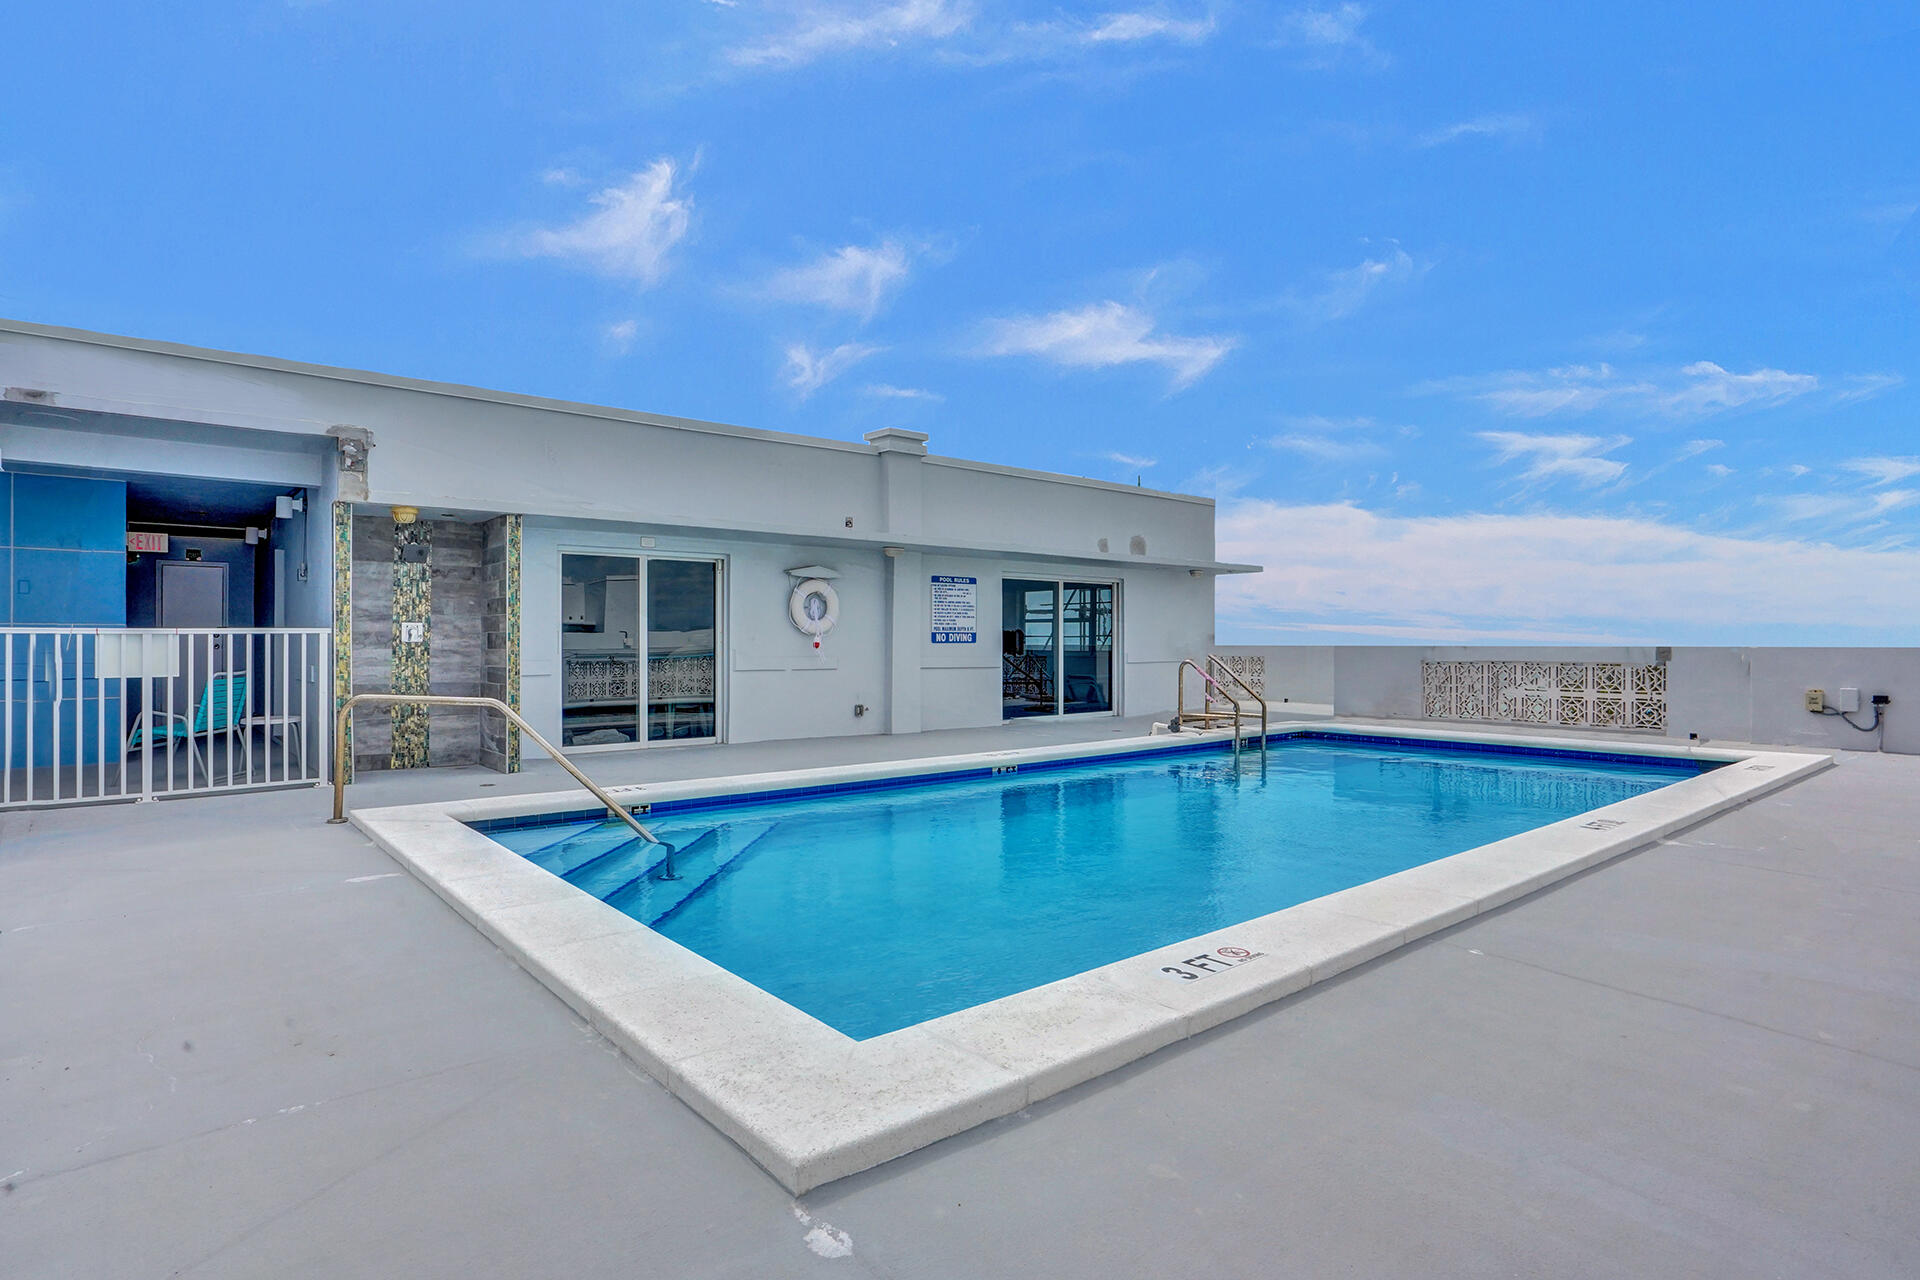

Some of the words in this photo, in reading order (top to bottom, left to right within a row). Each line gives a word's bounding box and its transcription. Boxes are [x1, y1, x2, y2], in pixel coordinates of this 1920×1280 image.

[136, 534, 163, 550] EXIT
[936, 633, 946, 642] NO
[949, 633, 972, 642] DIVING
[1161, 967, 1198, 980] 3
[1182, 954, 1232, 972] FT
